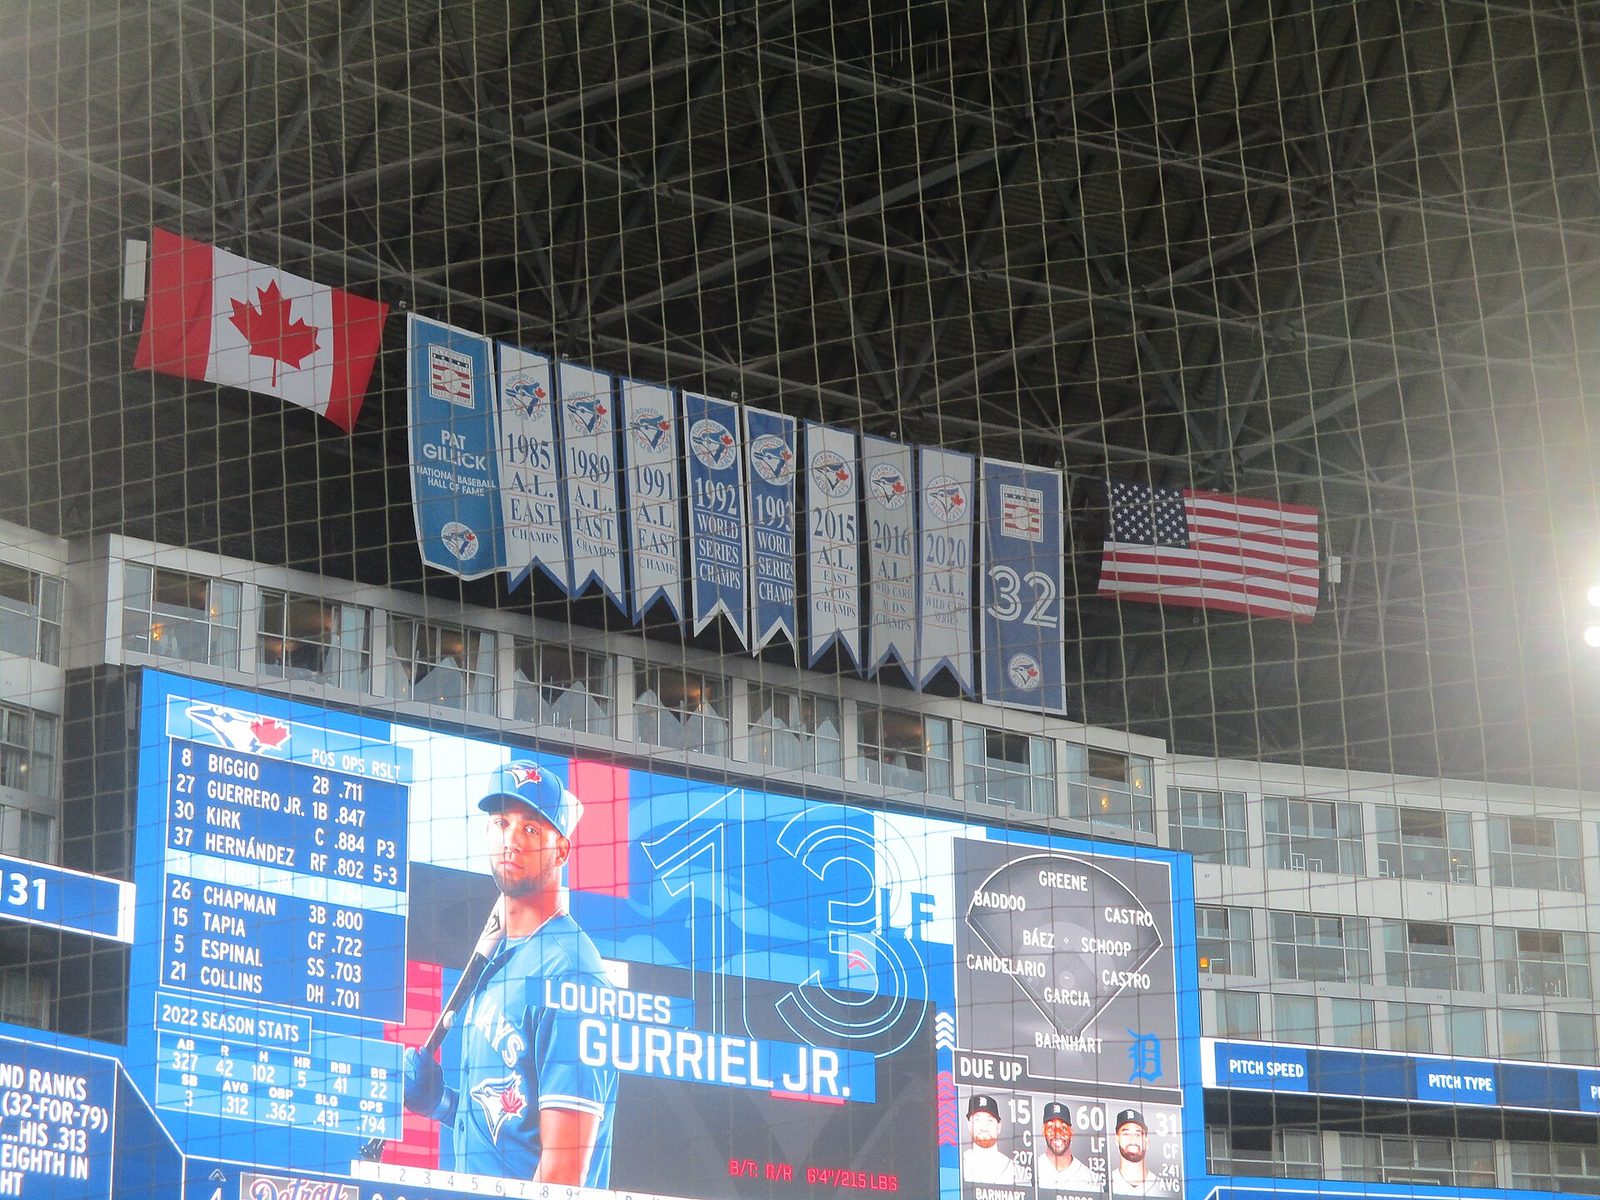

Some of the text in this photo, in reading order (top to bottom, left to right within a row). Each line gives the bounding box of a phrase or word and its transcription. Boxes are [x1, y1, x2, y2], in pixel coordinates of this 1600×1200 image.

[441, 430, 466, 450] PAT
[508, 433, 550, 469] 1985
[423, 443, 486, 471] GILLICK
[571, 446, 610, 483] 1989
[428, 477, 485, 496] HALL OF FAME
[457, 475, 496, 488] BASEBALL
[511, 471, 554, 498] A.L.
[636, 464, 672, 500] 1991
[575, 484, 613, 512] A.L.
[695, 477, 737, 515] 1992
[511, 498, 555, 526] EAST
[575, 508, 613, 540] EAST
[756, 494, 793, 531] 1993
[814, 507, 855, 543] 2015
[512, 528, 559, 543] CHAMPS
[697, 514, 738, 539] WORLD
[873, 519, 911, 556] 2016
[576, 537, 616, 558] CHAMPS
[639, 528, 676, 558] EAST
[699, 539, 738, 564] SERIES
[927, 533, 966, 569] 2020
[818, 545, 853, 571] A.L.
[700, 563, 740, 590] CHAMPS
[823, 570, 849, 585] EAST
[929, 572, 964, 596] A.L.
[816, 601, 856, 617] CHAMPS
[987, 565, 1057, 628] 32
[182, 748, 363, 802] 8 BIGGIO 2B .711
[312, 748, 400, 780] POS OPS RSLT
[176, 773, 366, 828] 27 GUERRERO JR. 1B .847
[174, 799, 395, 859] 30 KIRK C .884 P3
[173, 826, 398, 886] 37 HERNÁNDEZ RF .802 5-3
[1039, 870, 1088, 892] GREENE
[172, 879, 363, 931] 26 CHAPMAN 3B .800
[974, 890, 1026, 912] BADDOO
[1104, 907, 1153, 927] CASTRO
[172, 907, 363, 958] 15 TAPIA CF .722
[1023, 928, 1055, 949] BÁEZ
[174, 934, 362, 983] 5 ESPINAL SS .703
[1081, 937, 1132, 957] SCHOOP
[966, 953, 1046, 978] CANDELARIO
[1102, 969, 1151, 990] CASTRO
[170, 961, 360, 1009] 21 COLLINS DH .701
[1044, 987, 1091, 1007] GARCIA
[545, 979, 671, 1025] LOURDES
[162, 1004, 299, 1042] 2022 SEASON STATS
[1035, 1032, 1103, 1054] BARNHART
[177, 1038, 387, 1080] AB R H HR RBI BB
[579, 1018, 774, 1089] GURRIEL
[782, 1046, 850, 1097] JR.
[960, 1058, 1023, 1083] DUE UP
[1229, 1059, 1304, 1079] PITCH SPEED
[29, 1068, 87, 1101] RANKS
[172, 1051, 387, 1100] 327 42 102 5 41 22
[1428, 1073, 1493, 1093] PITCH TYPE
[223, 1080, 249, 1094] AVG
[269, 1087, 293, 1100] OBP
[315, 1093, 338, 1107] SLG
[359, 1099, 383, 1114] OPS
[2, 1091, 108, 1134] (32-FOR-79)
[184, 1090, 386, 1134] 3 .312 .362 .431 .794
[1008, 1099, 1031, 1125] 15
[1076, 1105, 1104, 1131] 60
[1156, 1112, 1177, 1138] 31
[53, 1127, 87, 1153] .313
[1023, 1130, 1032, 1147] C
[1091, 1136, 1105, 1153] LF
[1163, 1142, 1179, 1160] CF
[2, 1143, 88, 1180] EIGHTH IN
[1159, 1163, 1180, 1178] .241
[399, 1168, 406, 1182] 2
[424, 1171, 431, 1185] 3
[447, 1175, 454, 1188] 4
[471, 1177, 479, 1190] 5
[495, 1181, 503, 1194] 6
[519, 1183, 525, 1196] 7
[542, 1185, 549, 1198] 8
[566, 1188, 573, 1200] 9
[765, 1163, 793, 1182] R/R
[869, 1174, 898, 1192] LBS
